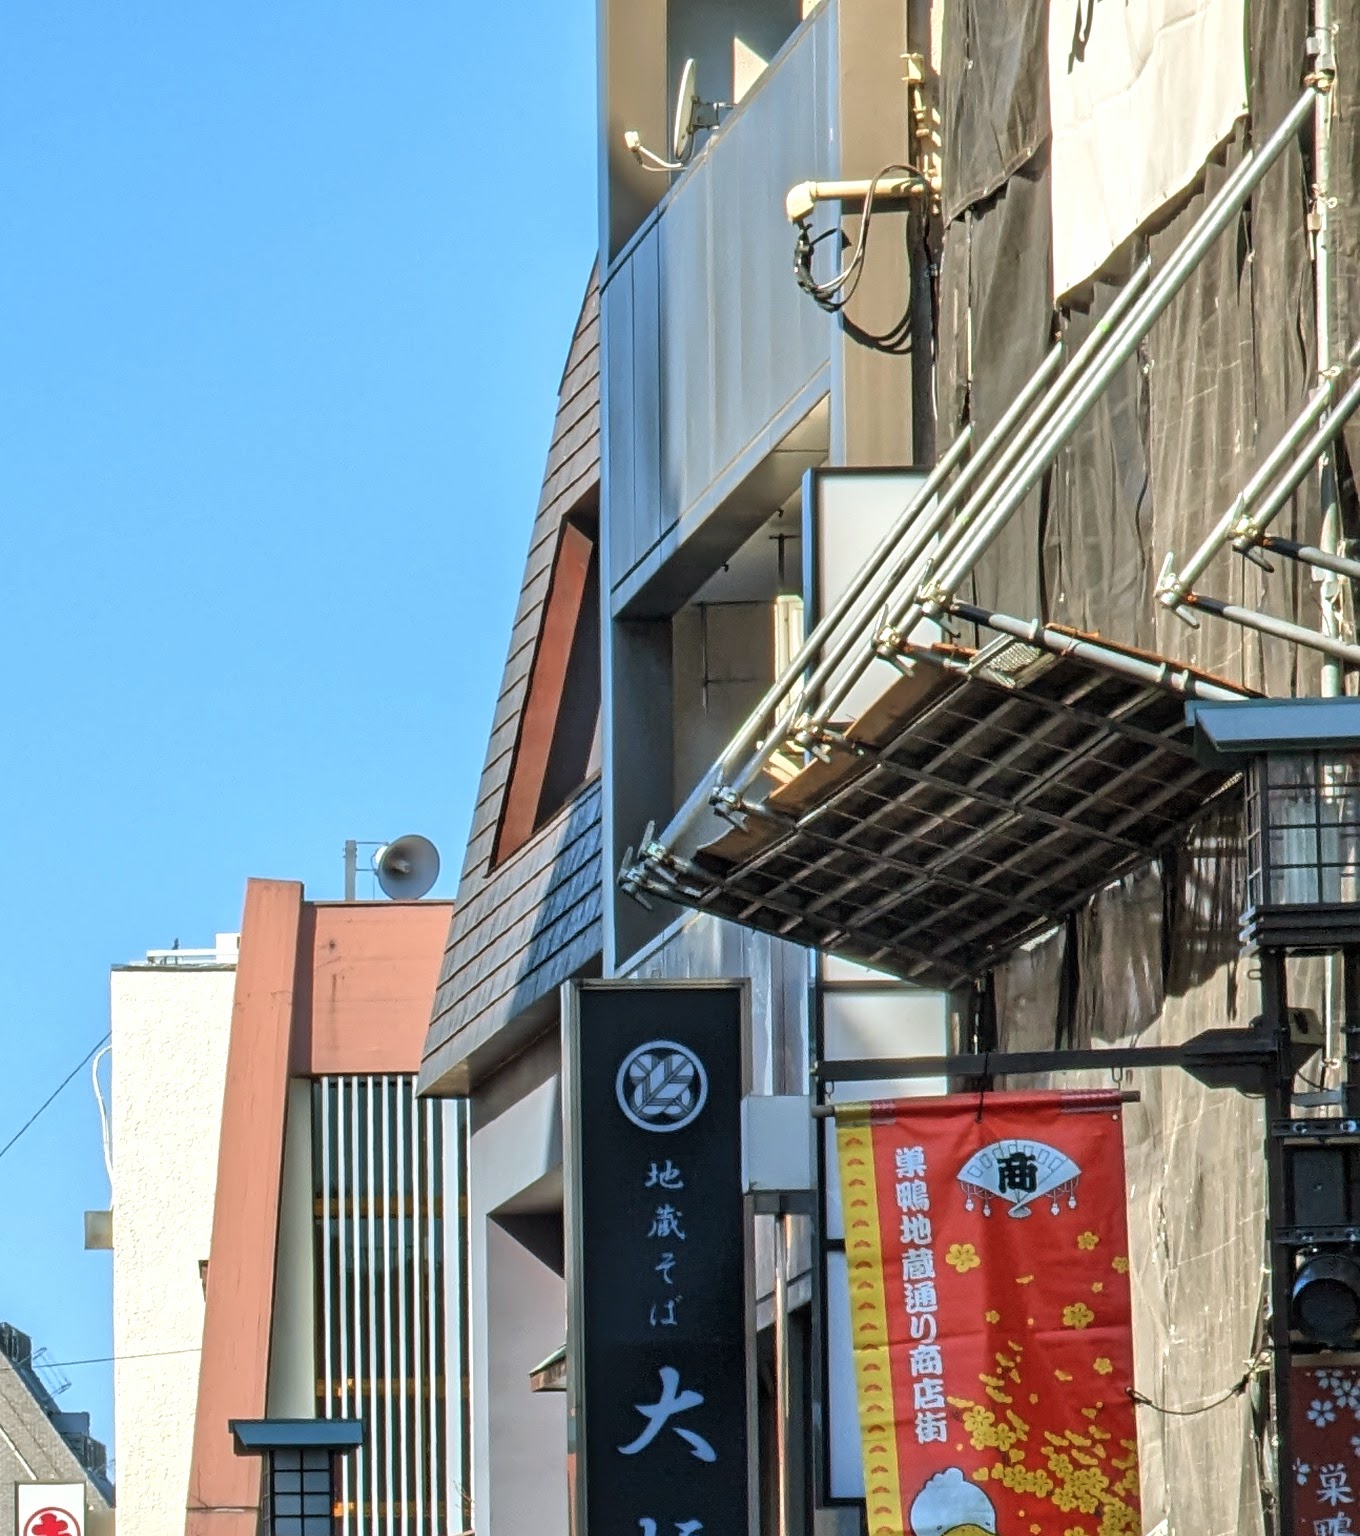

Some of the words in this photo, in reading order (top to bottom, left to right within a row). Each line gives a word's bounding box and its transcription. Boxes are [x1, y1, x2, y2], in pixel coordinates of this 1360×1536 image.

[644, 1160, 686, 1329] 地蔵そば
[997, 1151, 1038, 1194] 商
[893, 1145, 948, 1443] 巣鴨地蔵通り商店街
